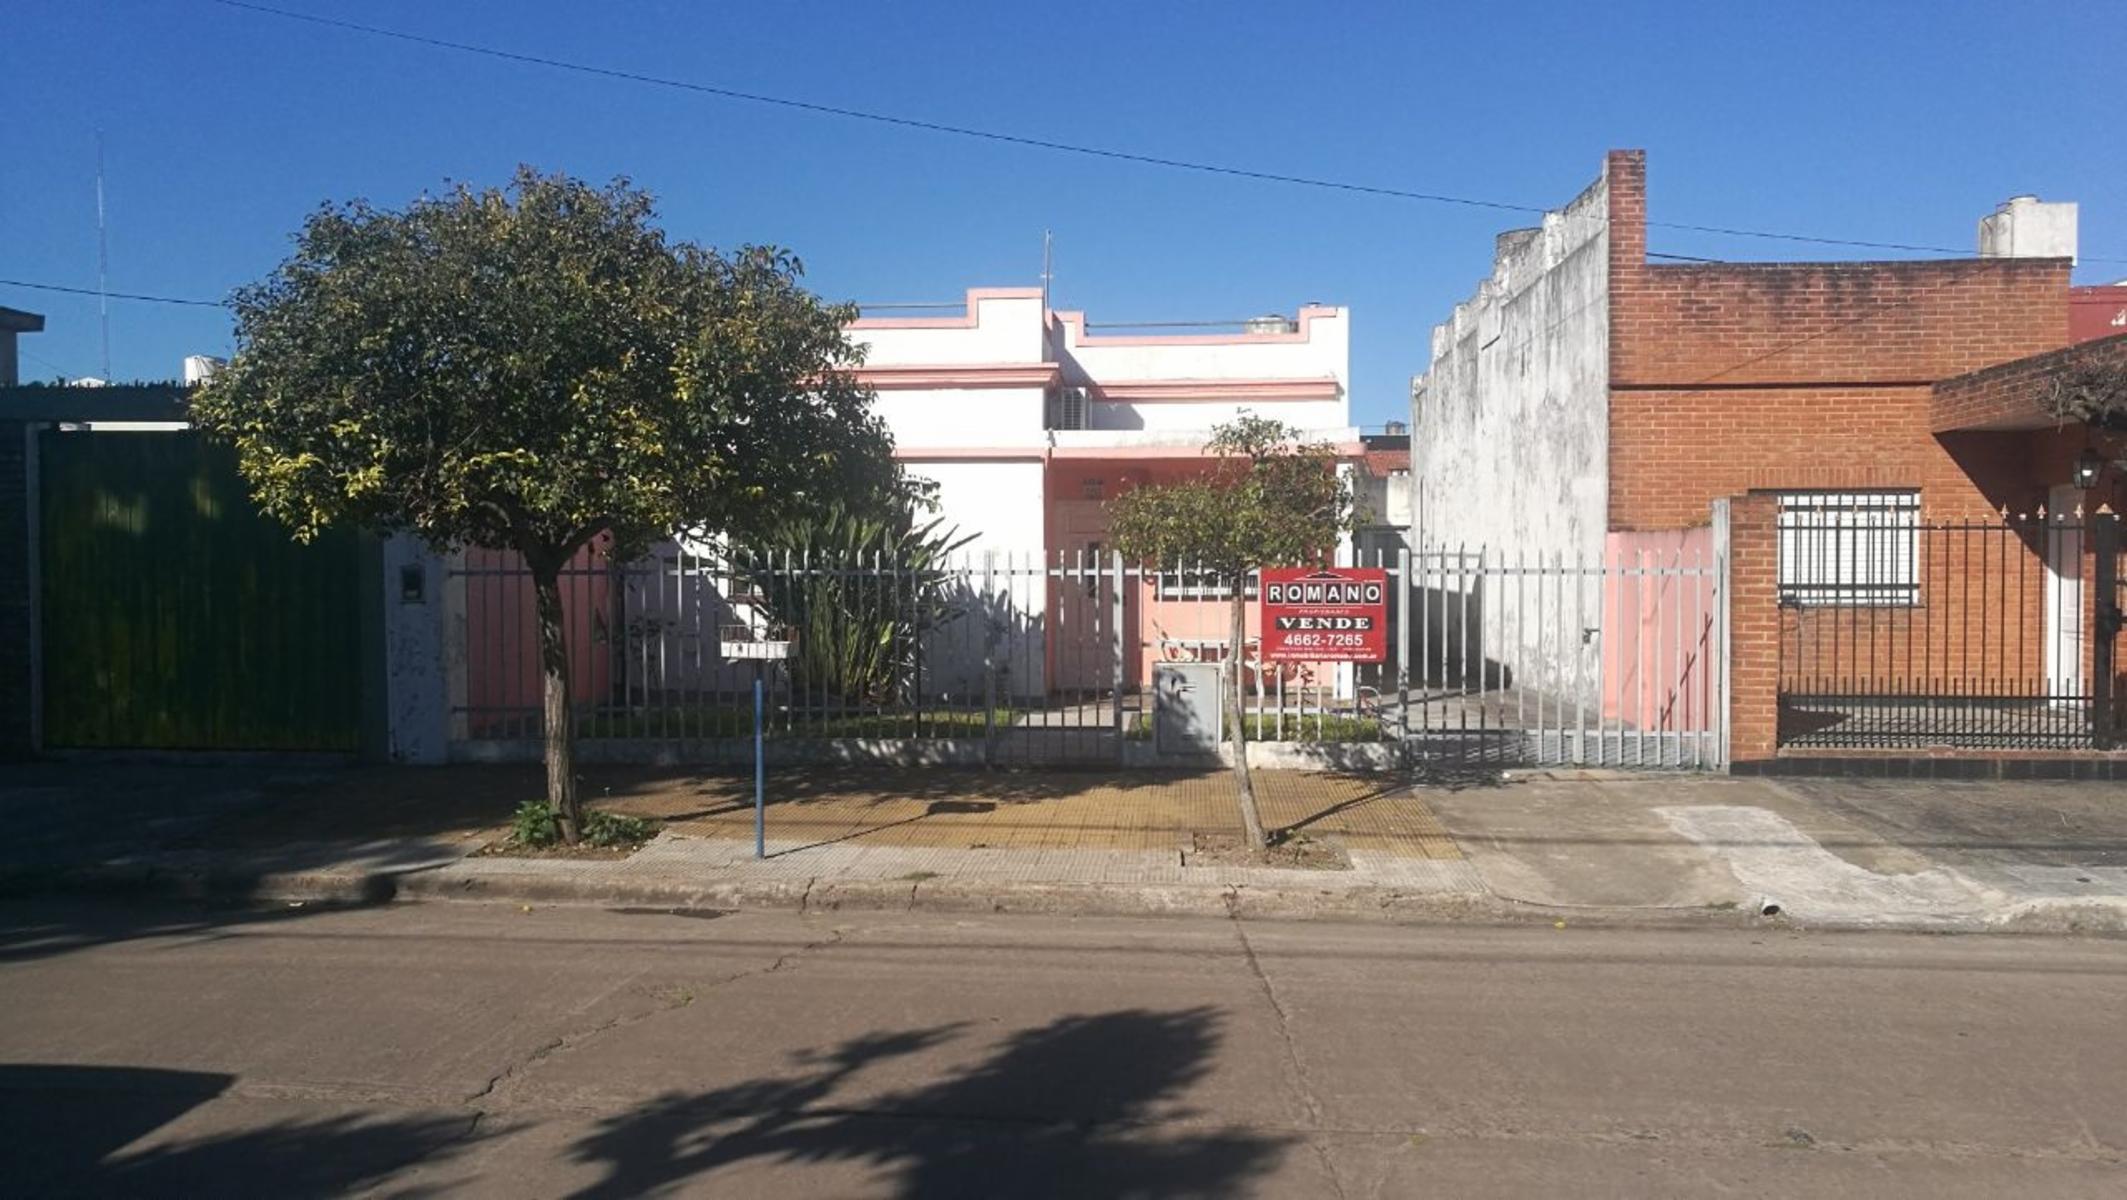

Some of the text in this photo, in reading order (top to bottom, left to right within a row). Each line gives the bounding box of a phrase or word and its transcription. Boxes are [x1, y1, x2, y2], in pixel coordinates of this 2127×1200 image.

[1269, 585, 1380, 600] ROMANO
[1280, 617, 1370, 629] VENDE
[1283, 634, 1364, 646] 4662-7265
